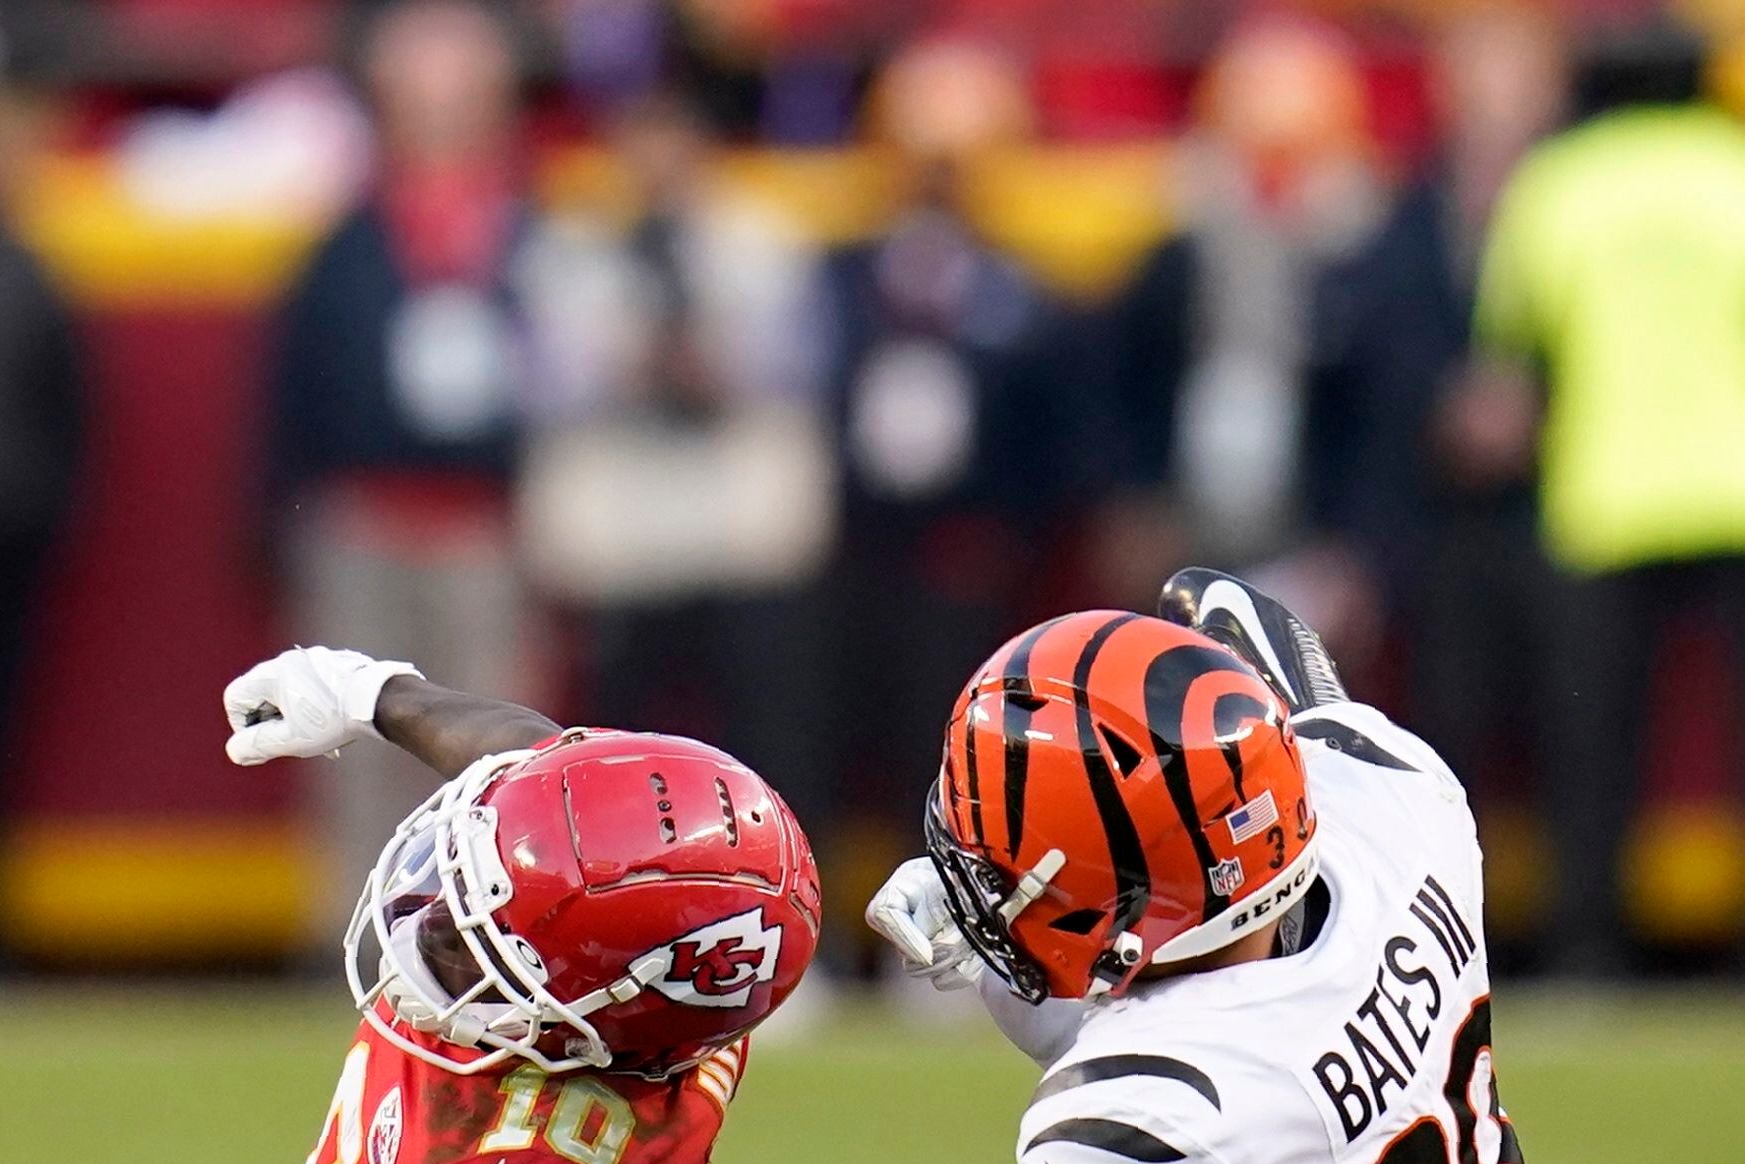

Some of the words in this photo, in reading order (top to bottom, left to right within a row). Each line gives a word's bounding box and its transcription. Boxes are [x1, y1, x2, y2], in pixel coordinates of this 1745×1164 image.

[663, 936, 766, 997] KC
[1312, 935, 1442, 1144] BATES
[1408, 883, 1477, 979] III
